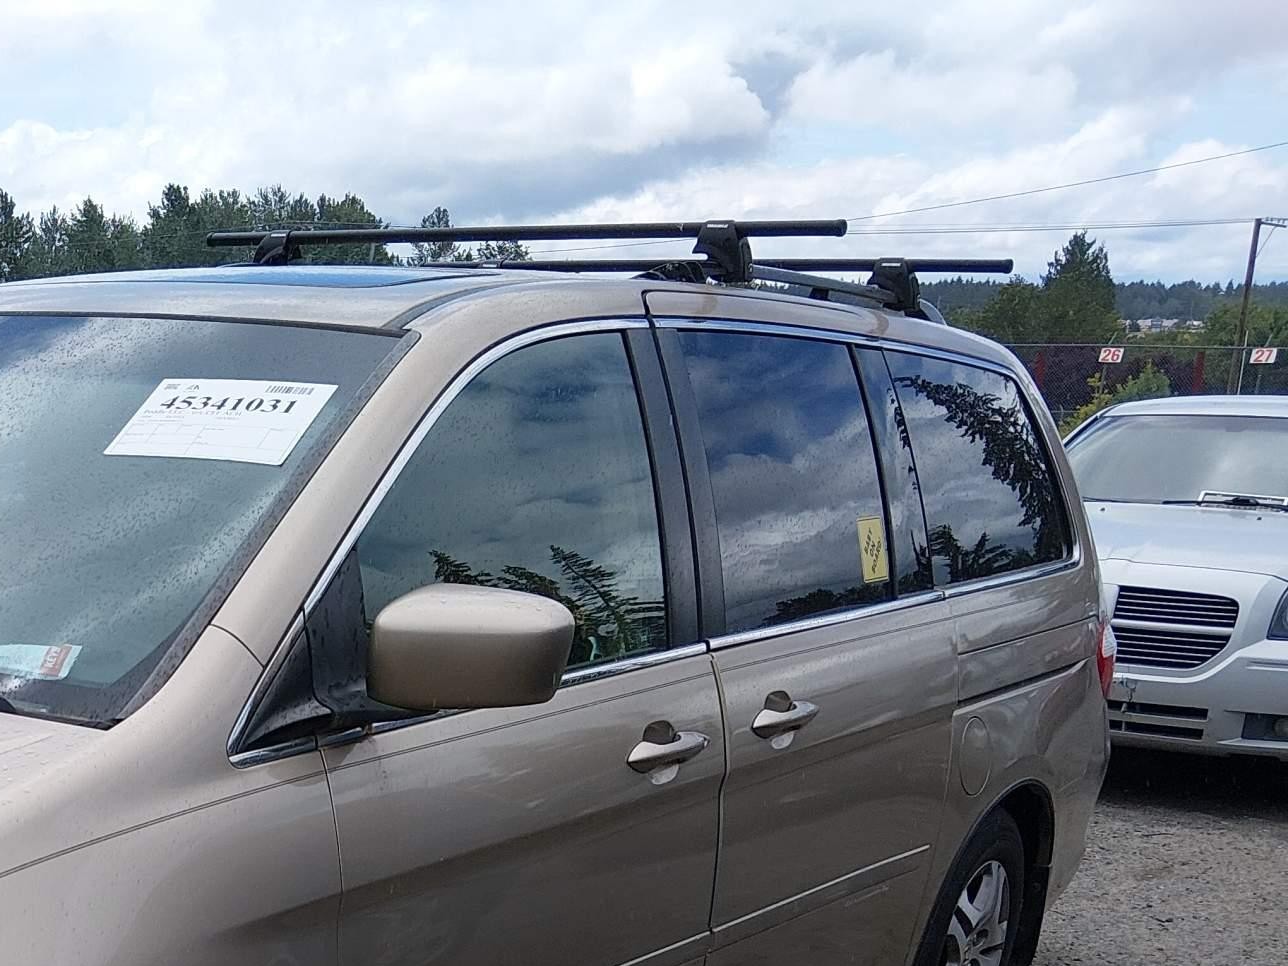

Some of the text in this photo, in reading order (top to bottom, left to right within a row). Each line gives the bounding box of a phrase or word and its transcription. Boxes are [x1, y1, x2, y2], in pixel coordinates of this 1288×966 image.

[1100, 348, 1121, 362] 26
[1253, 349, 1274, 363] 27
[159, 395, 297, 414] 45341031
